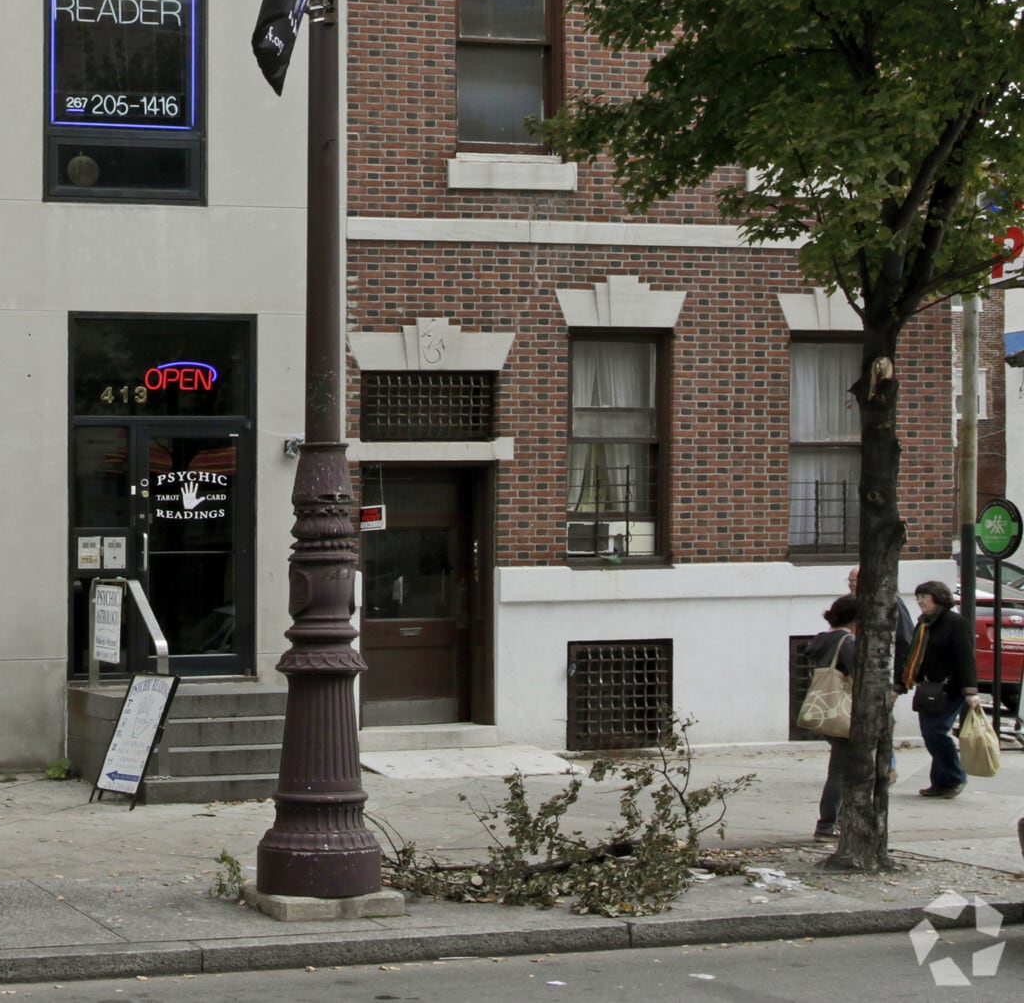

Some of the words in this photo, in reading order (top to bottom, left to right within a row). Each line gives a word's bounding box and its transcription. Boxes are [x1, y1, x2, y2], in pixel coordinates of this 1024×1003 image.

[66, 96, 88, 110] 267
[91, 94, 178, 117] 205-1416
[144, 367, 213, 391] OPEN
[100, 385, 148, 404] 413
[156, 470, 228, 486] PSYCHIC
[156, 493, 180, 501] TAROT
[206, 493, 227, 501] CARD
[156, 508, 226, 520] READINGS
[96, 589, 121, 607] PSYCHIC
